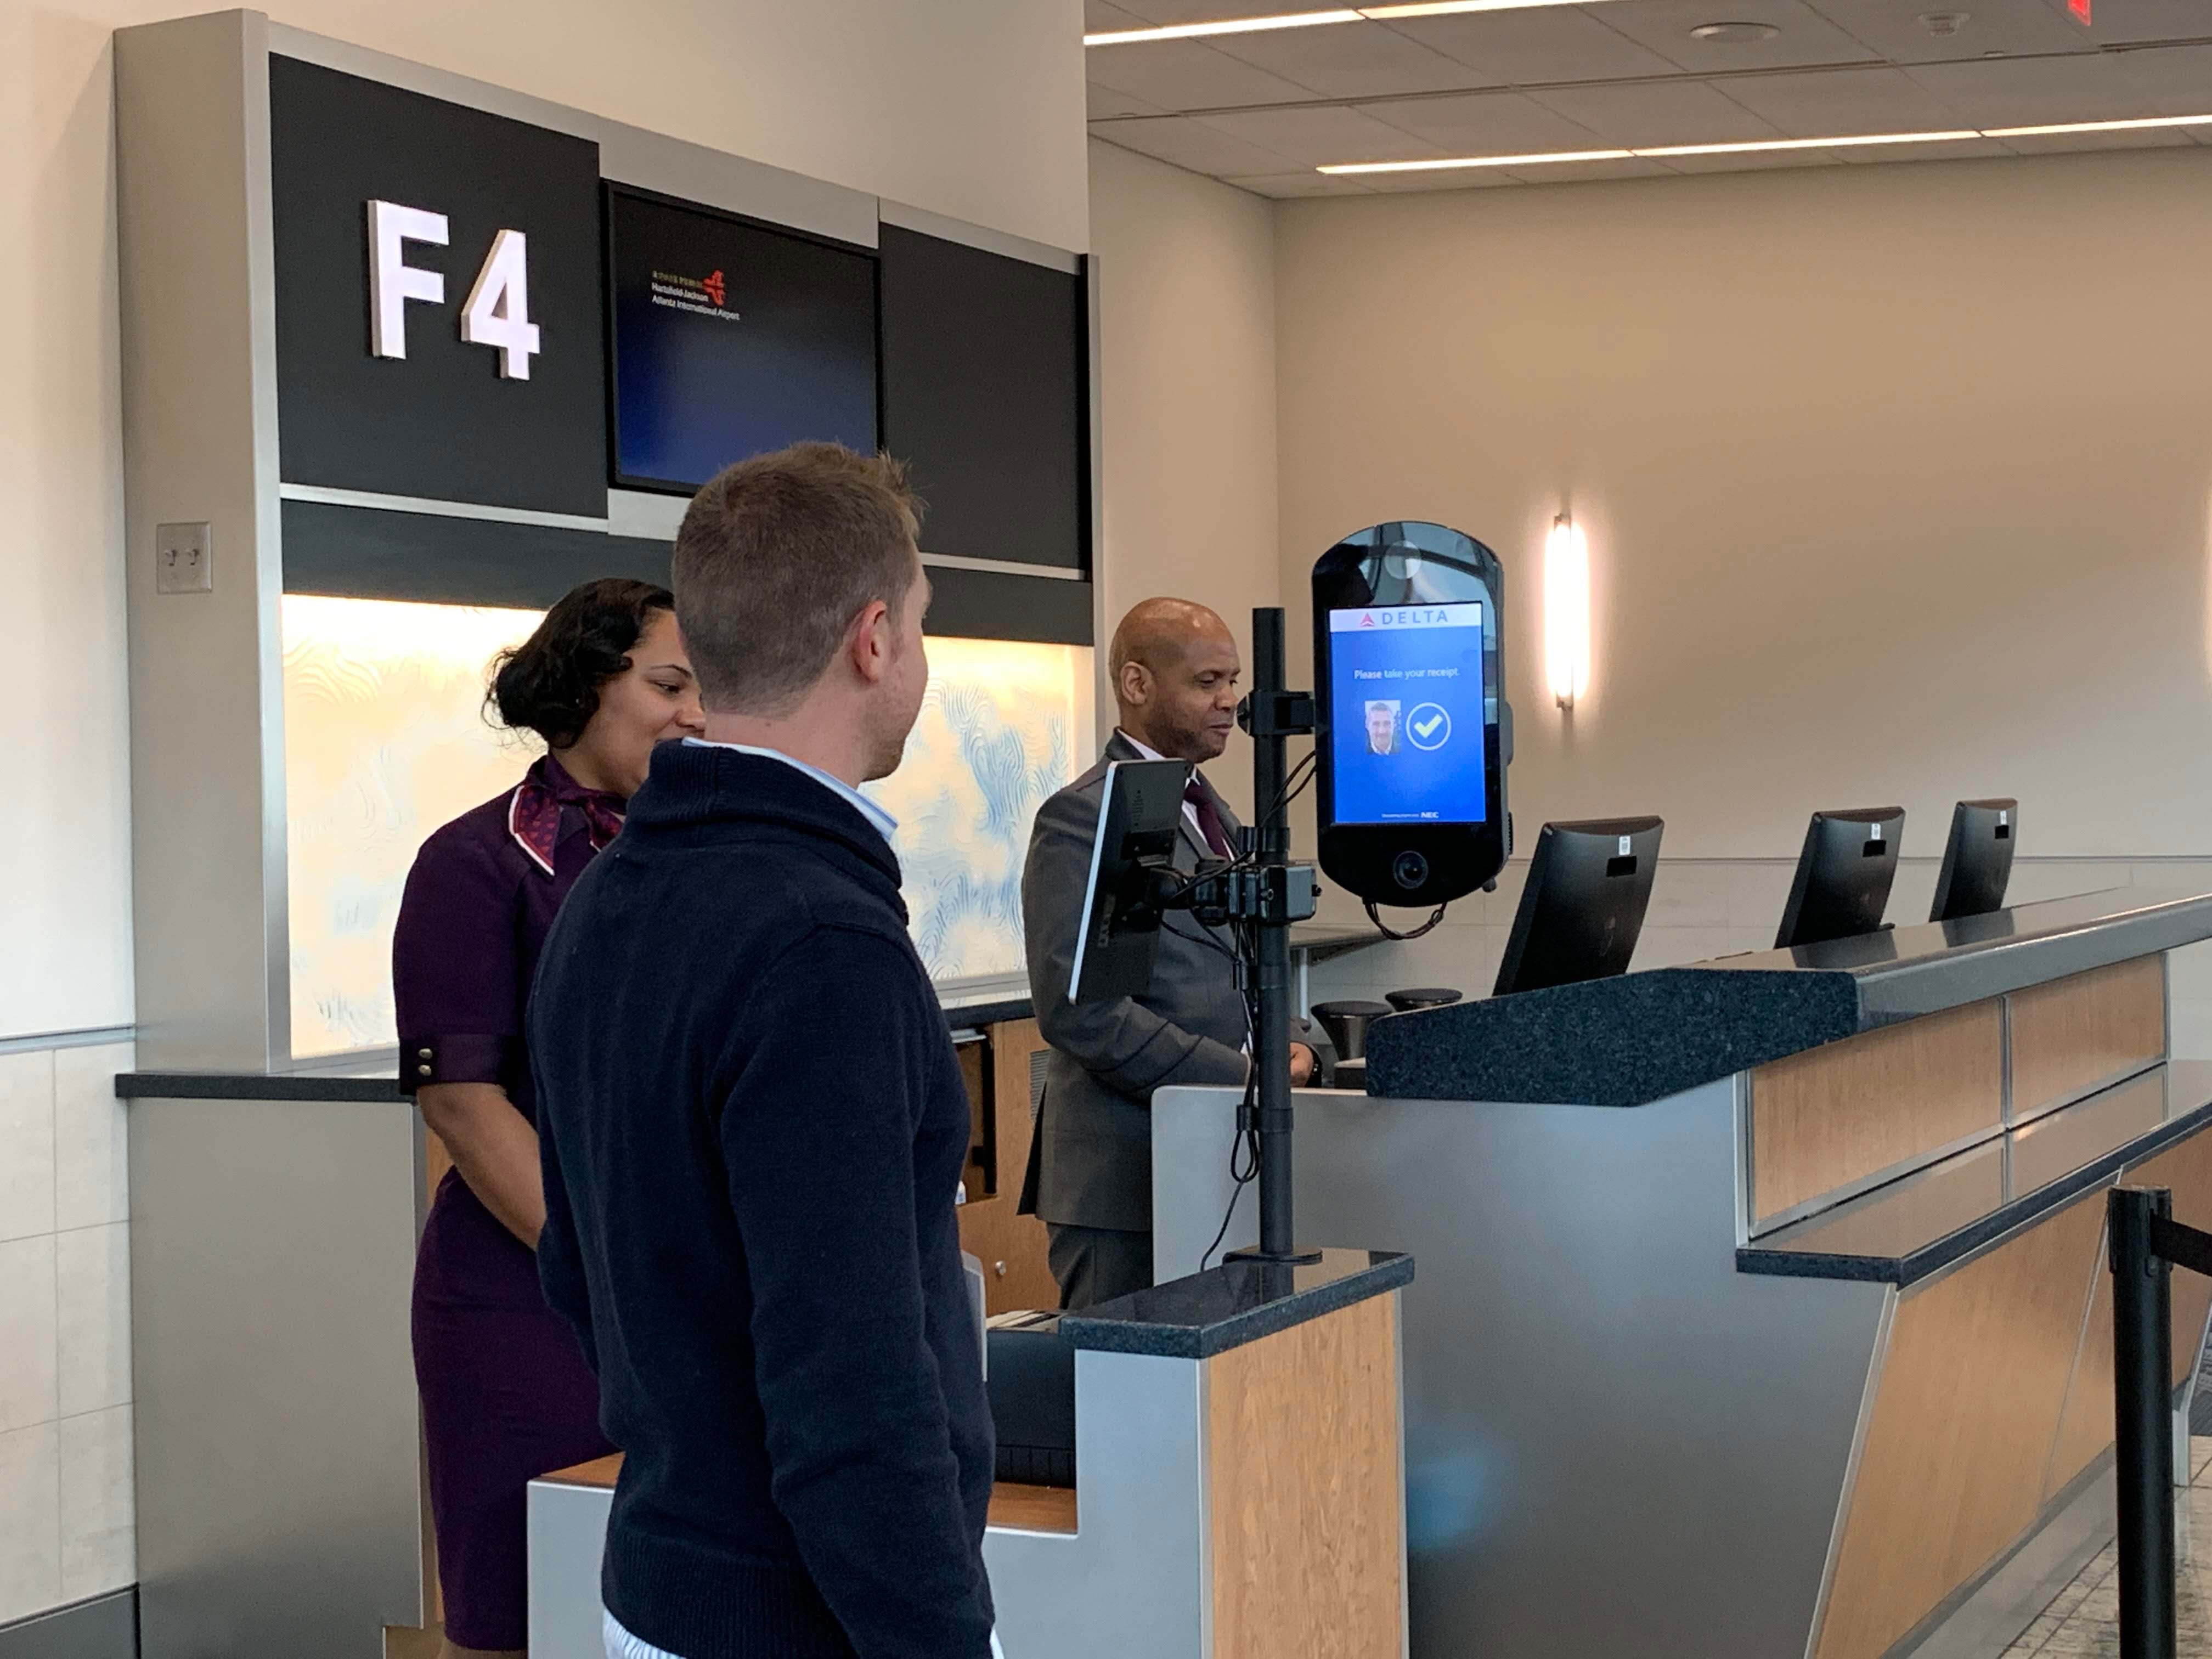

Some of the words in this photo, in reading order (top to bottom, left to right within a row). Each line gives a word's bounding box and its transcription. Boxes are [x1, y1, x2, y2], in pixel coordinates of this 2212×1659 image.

[1381, 610, 1448, 625] DELTA
[1354, 669, 1382, 679] Please
[1384, 669, 1403, 679] take
[1404, 669, 1425, 680] your
